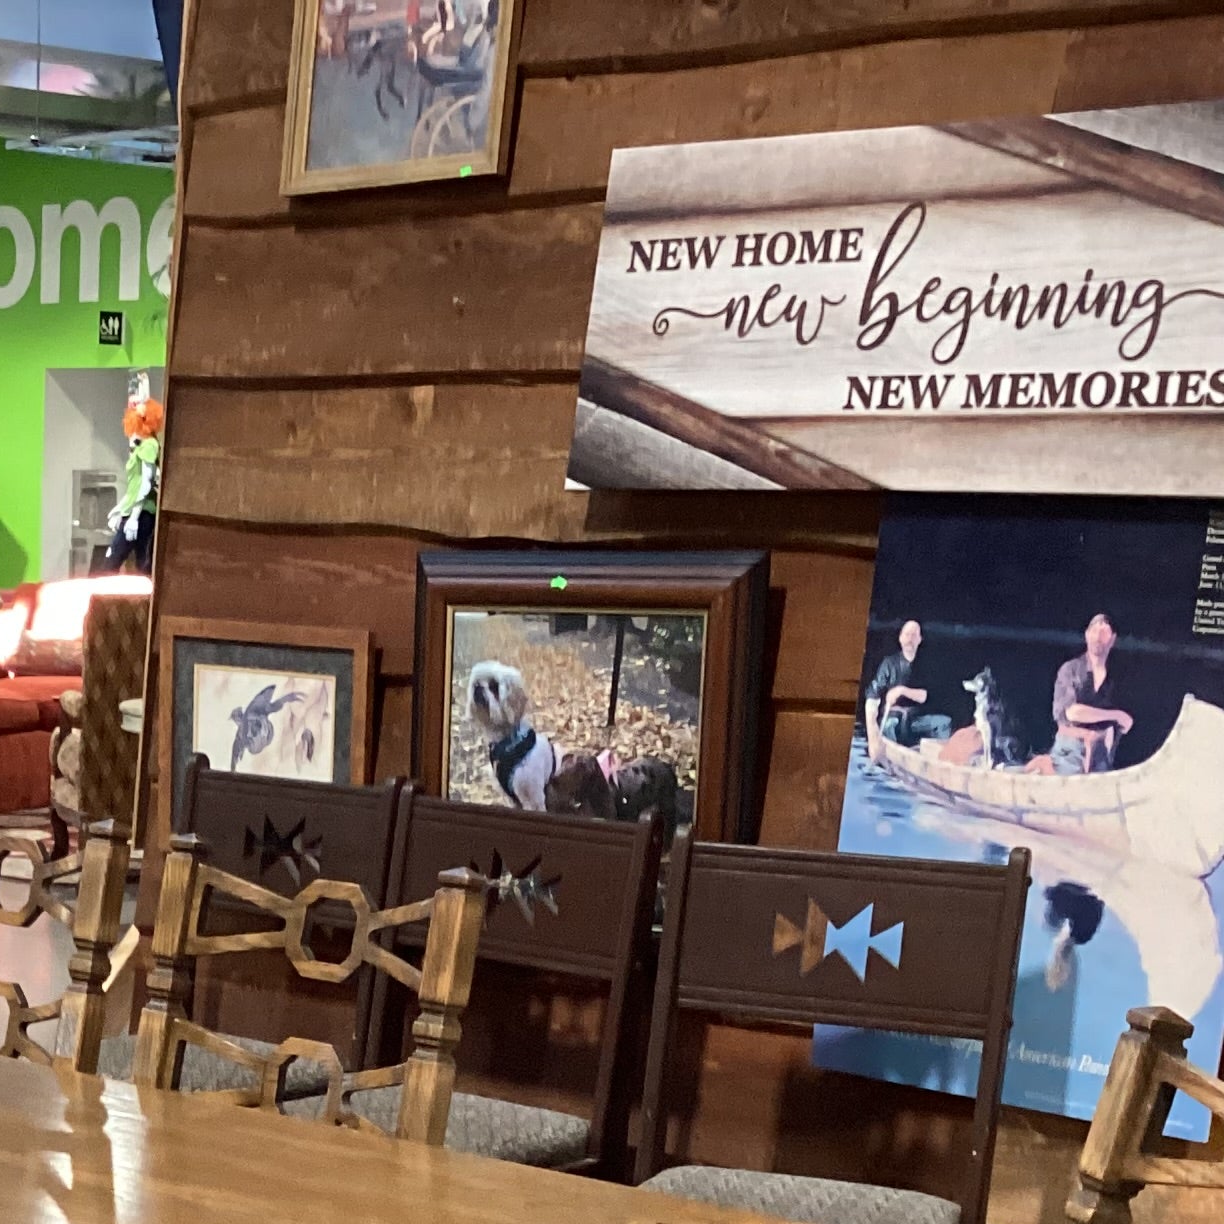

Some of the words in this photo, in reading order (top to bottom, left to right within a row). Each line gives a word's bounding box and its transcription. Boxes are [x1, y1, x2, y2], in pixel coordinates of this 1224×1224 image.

[626, 235, 727, 273] NEW
[732, 227, 864, 267] HOME
[653, 283, 847, 346] new
[856, 201, 1224, 365] beginning
[842, 374, 955, 410] NEW
[961, 370, 1224, 410] MEMORIES
